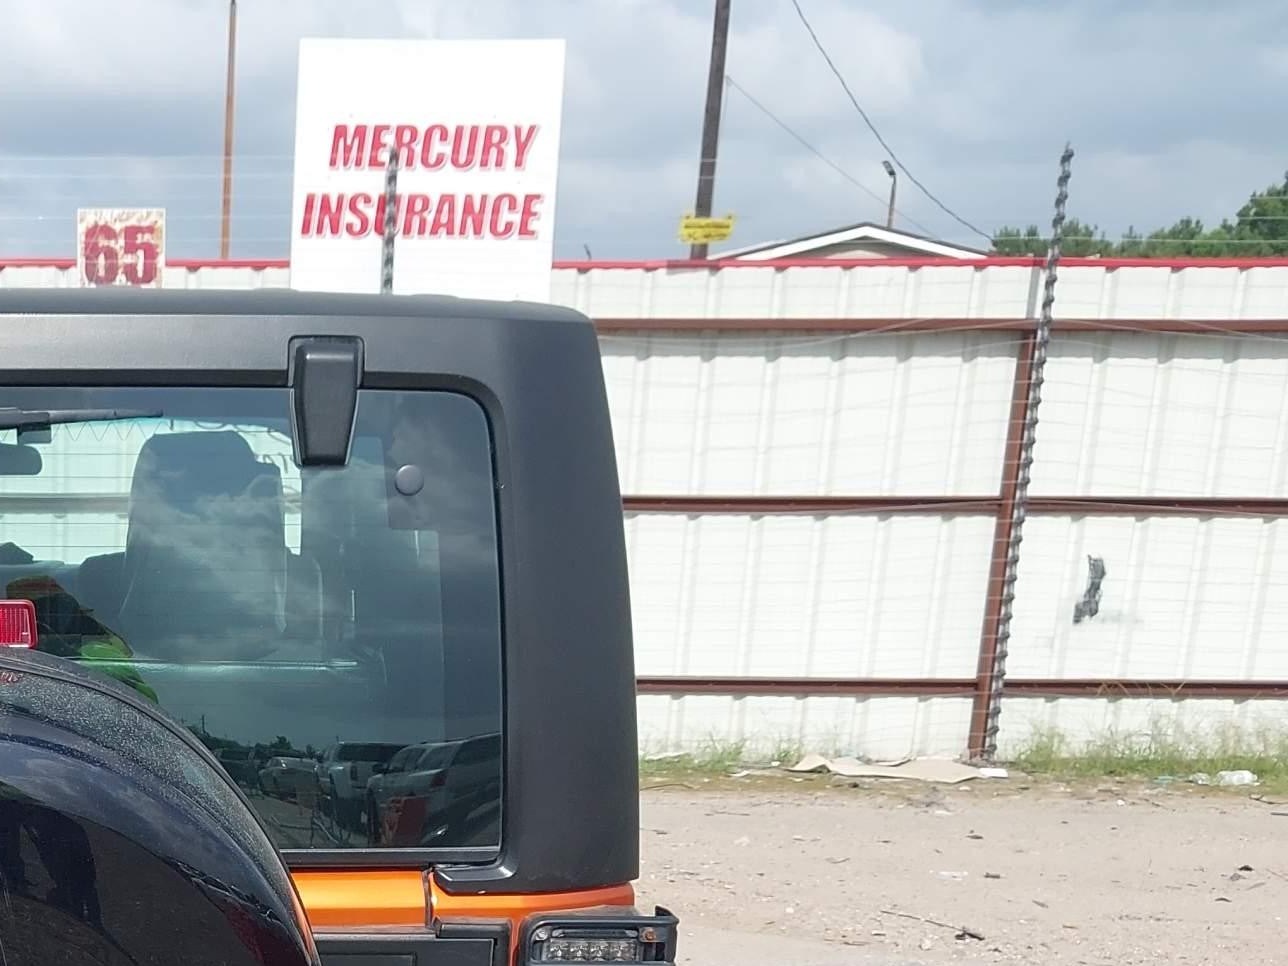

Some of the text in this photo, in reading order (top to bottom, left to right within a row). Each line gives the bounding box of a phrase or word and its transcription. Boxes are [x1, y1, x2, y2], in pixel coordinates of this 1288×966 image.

[329, 124, 537, 170] MERCURY
[301, 193, 541, 238] INSURANCE
[85, 224, 158, 285] 65
